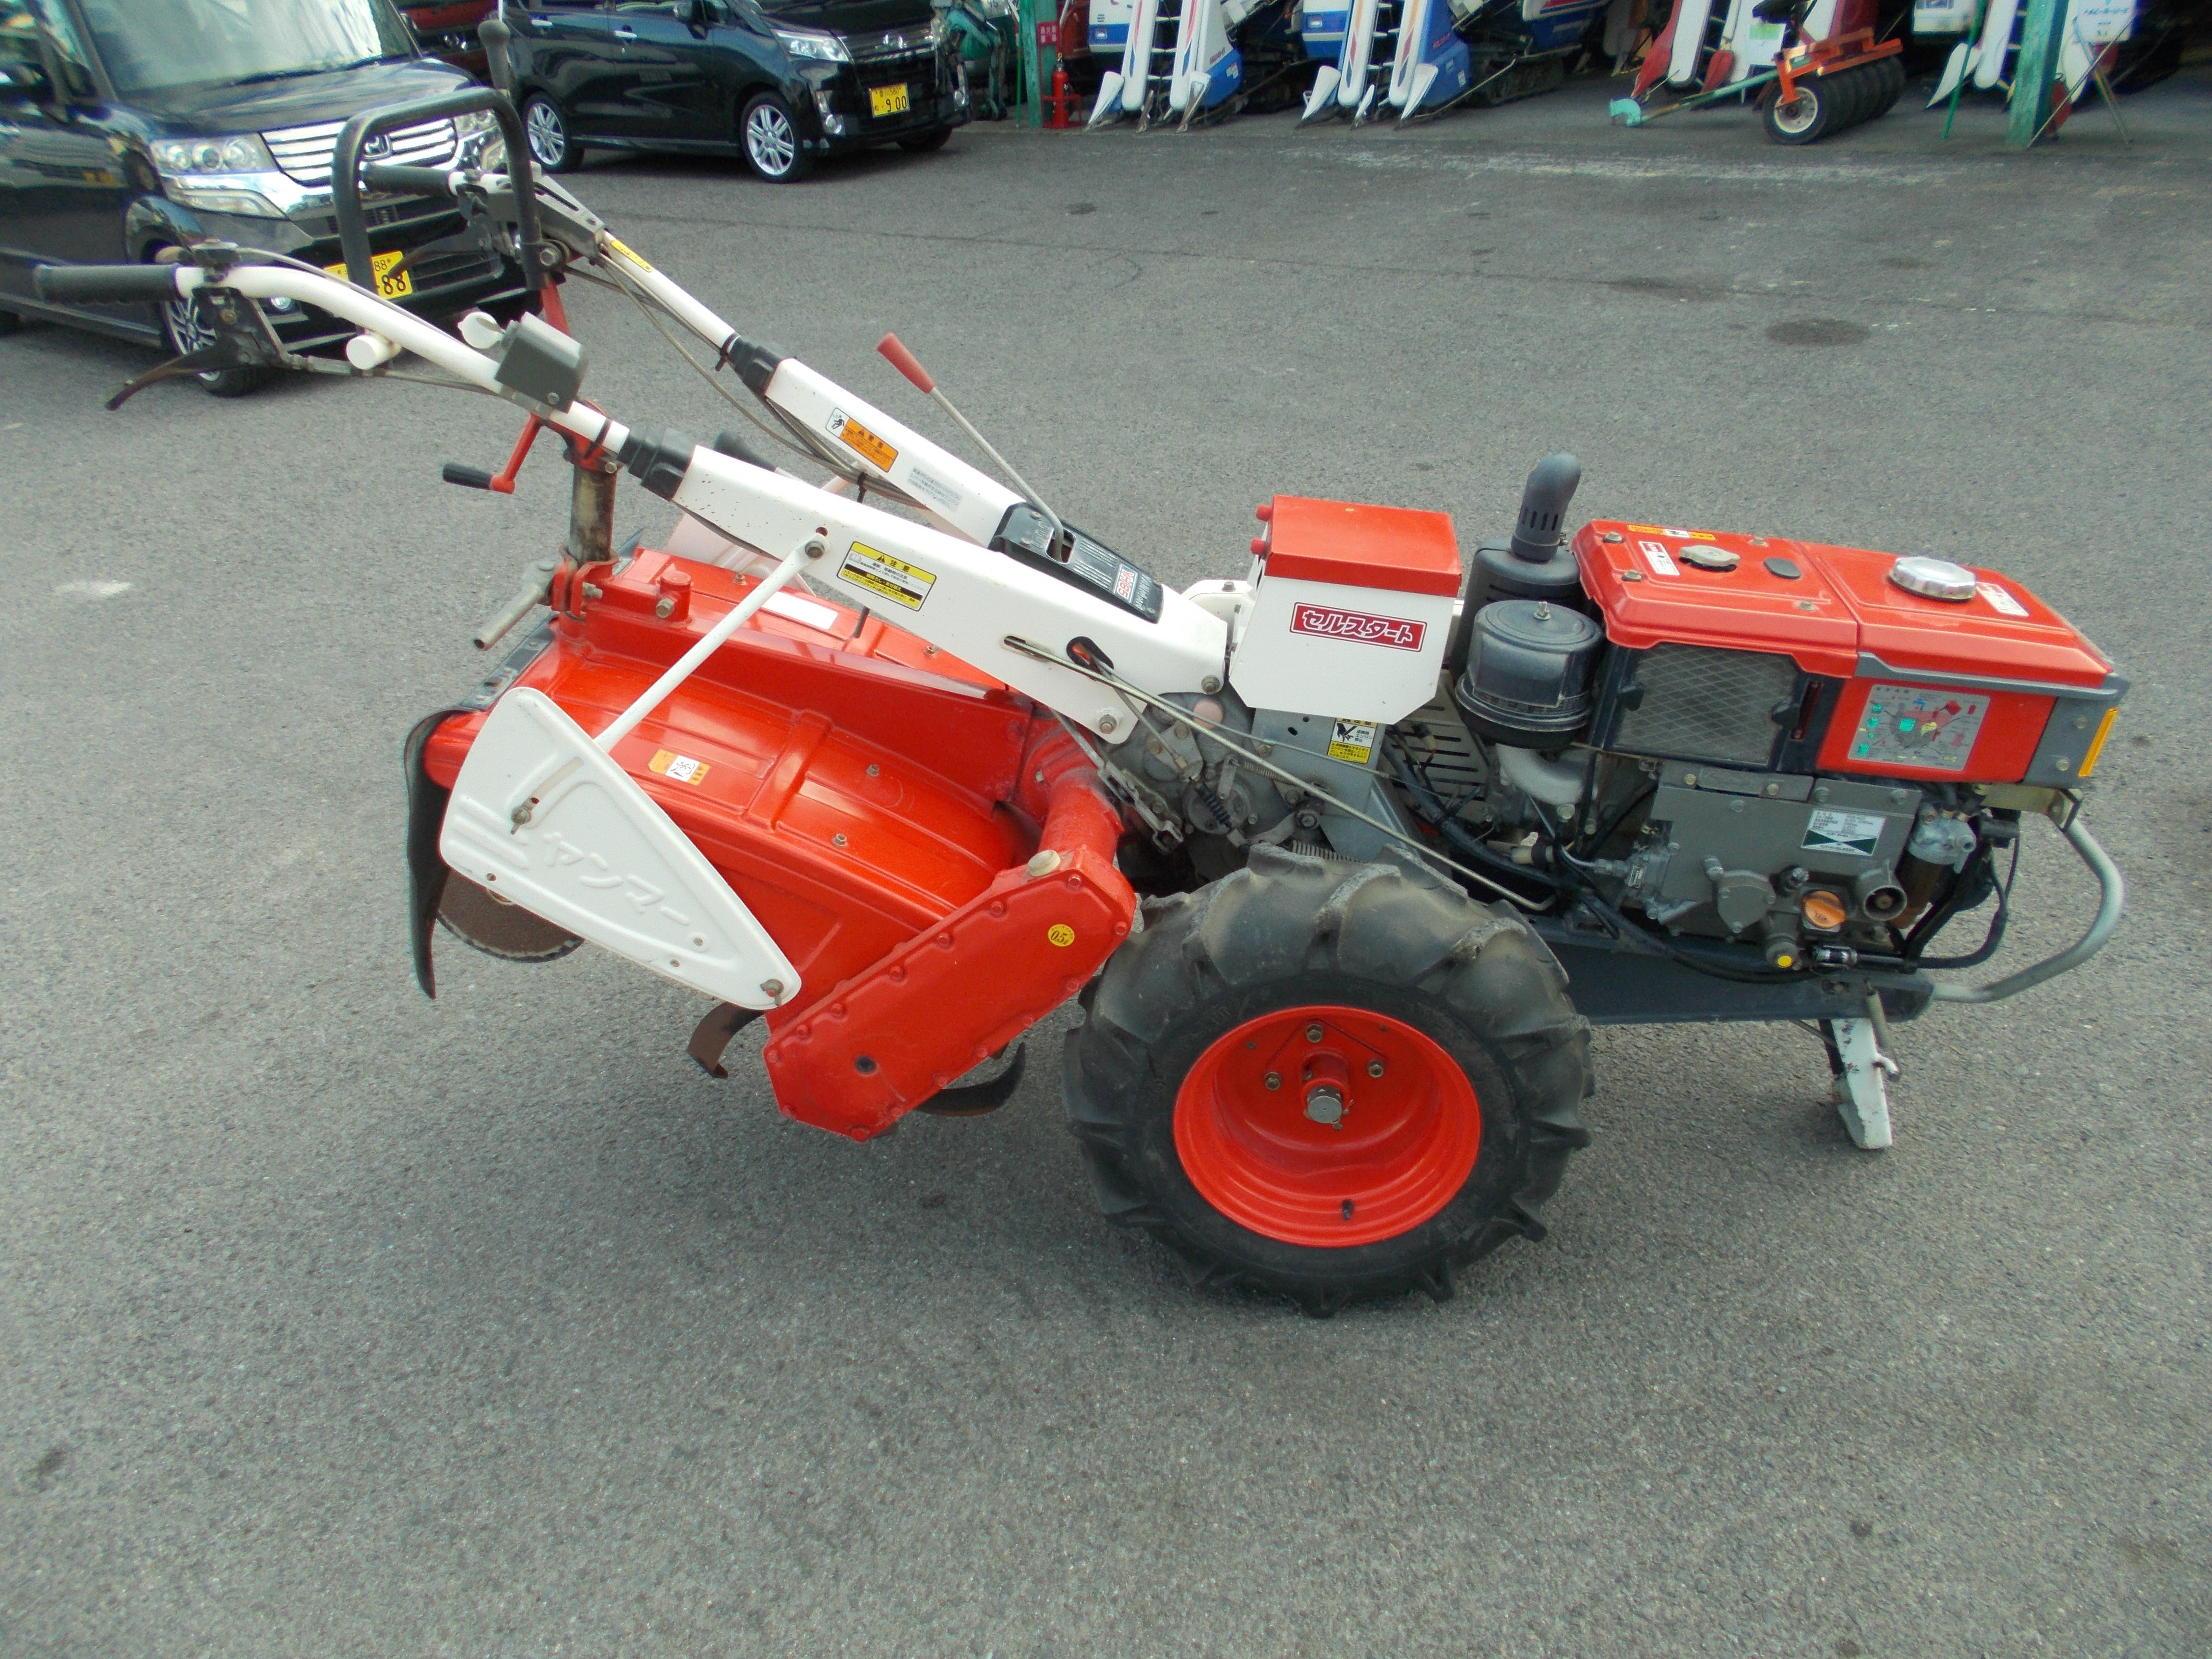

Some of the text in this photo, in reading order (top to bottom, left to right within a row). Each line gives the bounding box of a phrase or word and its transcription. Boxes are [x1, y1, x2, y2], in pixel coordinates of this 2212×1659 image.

[1117, 569, 1134, 600] YH85
[1302, 610, 1413, 644] セルスタート
[543, 831, 690, 926] ヤンマー
